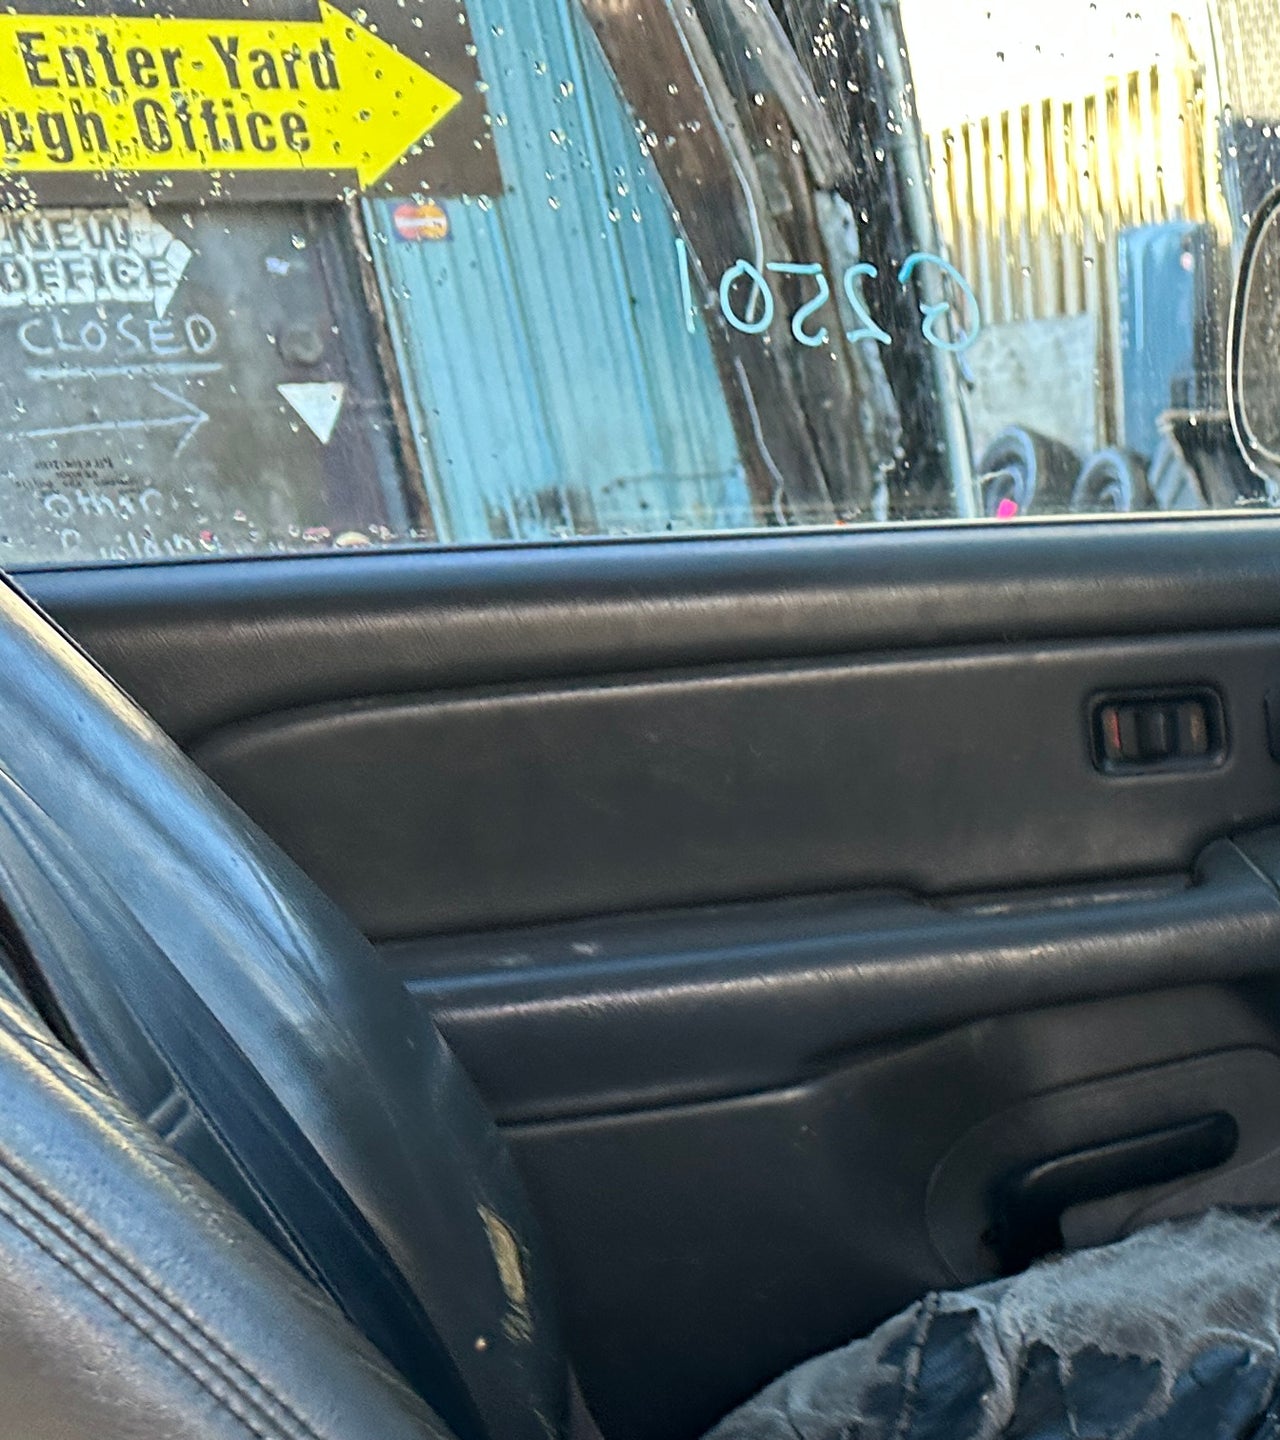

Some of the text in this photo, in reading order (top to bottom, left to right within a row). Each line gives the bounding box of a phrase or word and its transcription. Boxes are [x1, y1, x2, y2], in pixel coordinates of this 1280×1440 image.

[16, 30, 341, 91] Enter Yard
[132, 97, 312, 153] Office
[0, 255, 173, 295] OFFICE
[17, 312, 218, 355] CLOSED
